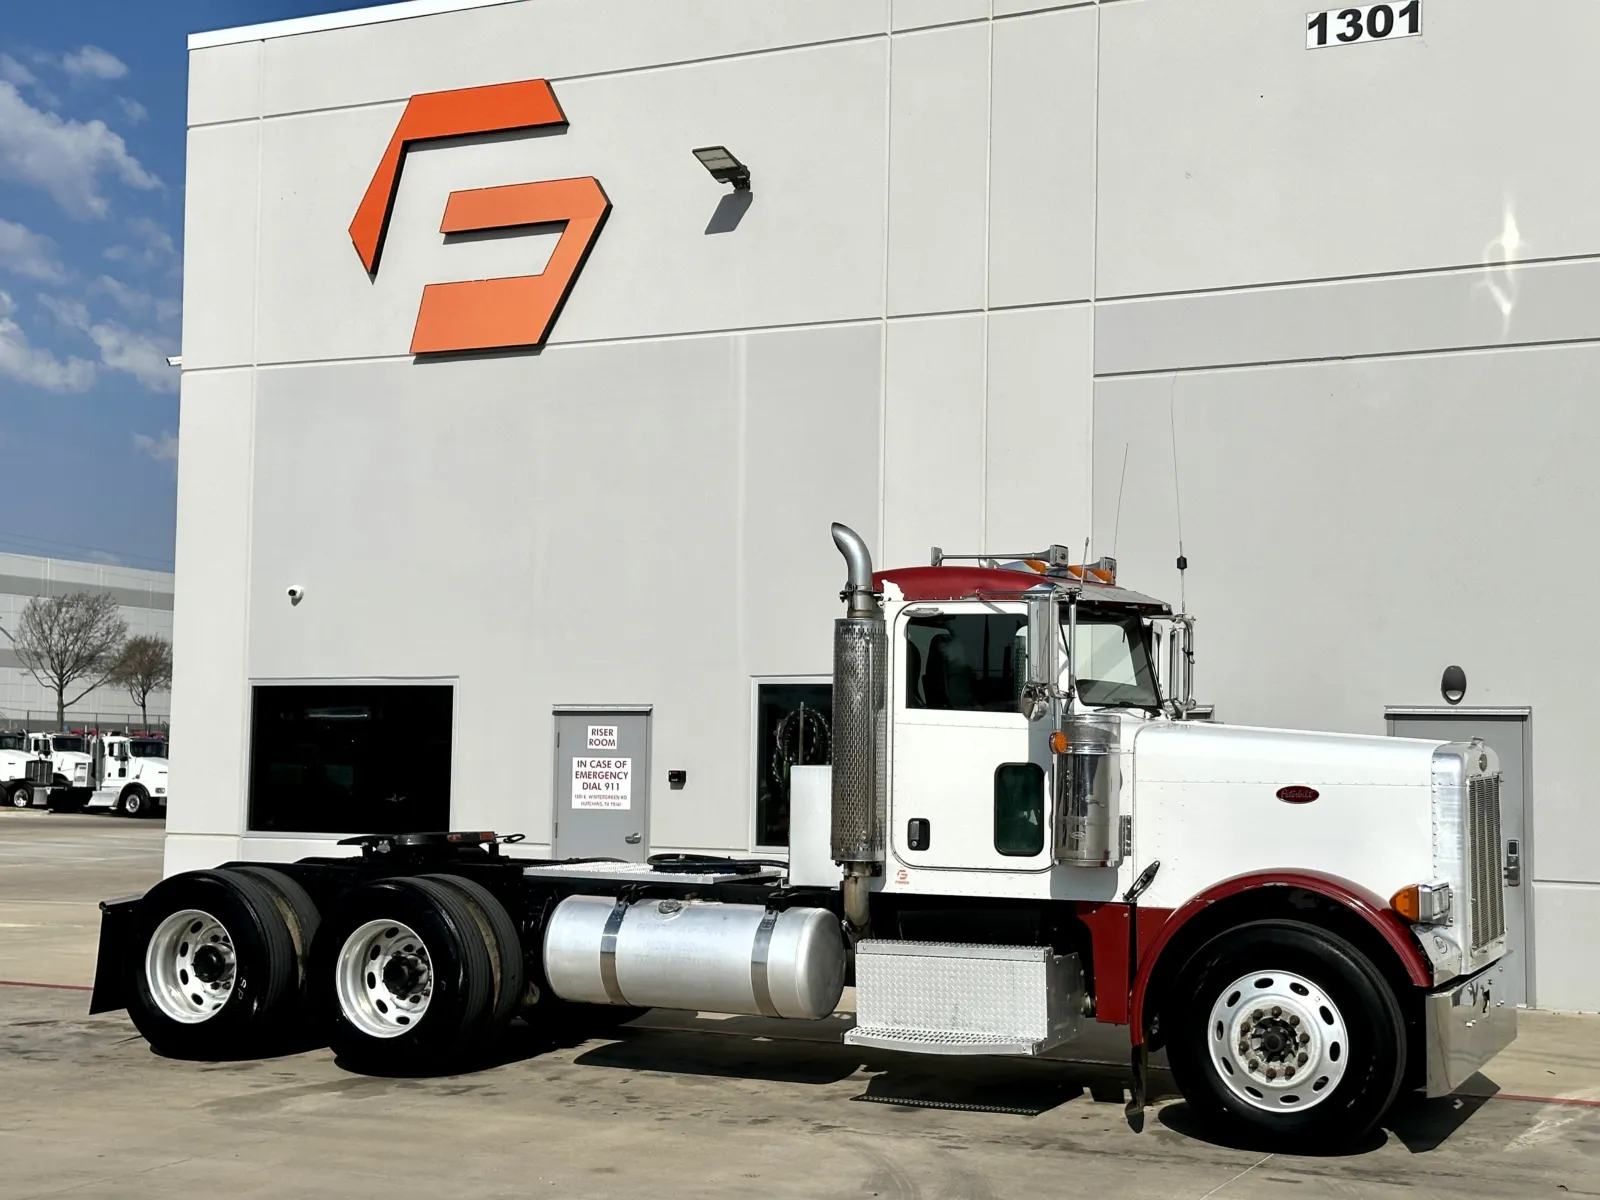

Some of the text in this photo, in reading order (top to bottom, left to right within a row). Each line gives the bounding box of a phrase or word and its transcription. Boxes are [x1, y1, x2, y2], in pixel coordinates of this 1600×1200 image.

[1308, 0, 1419, 45] 1301
[591, 728, 614, 737] RISER
[588, 738, 616, 747] ROOM
[577, 760, 627, 769] IN CASE OF
[575, 771, 629, 780] EMERGENCY
[582, 782, 620, 791] DIAL 911
